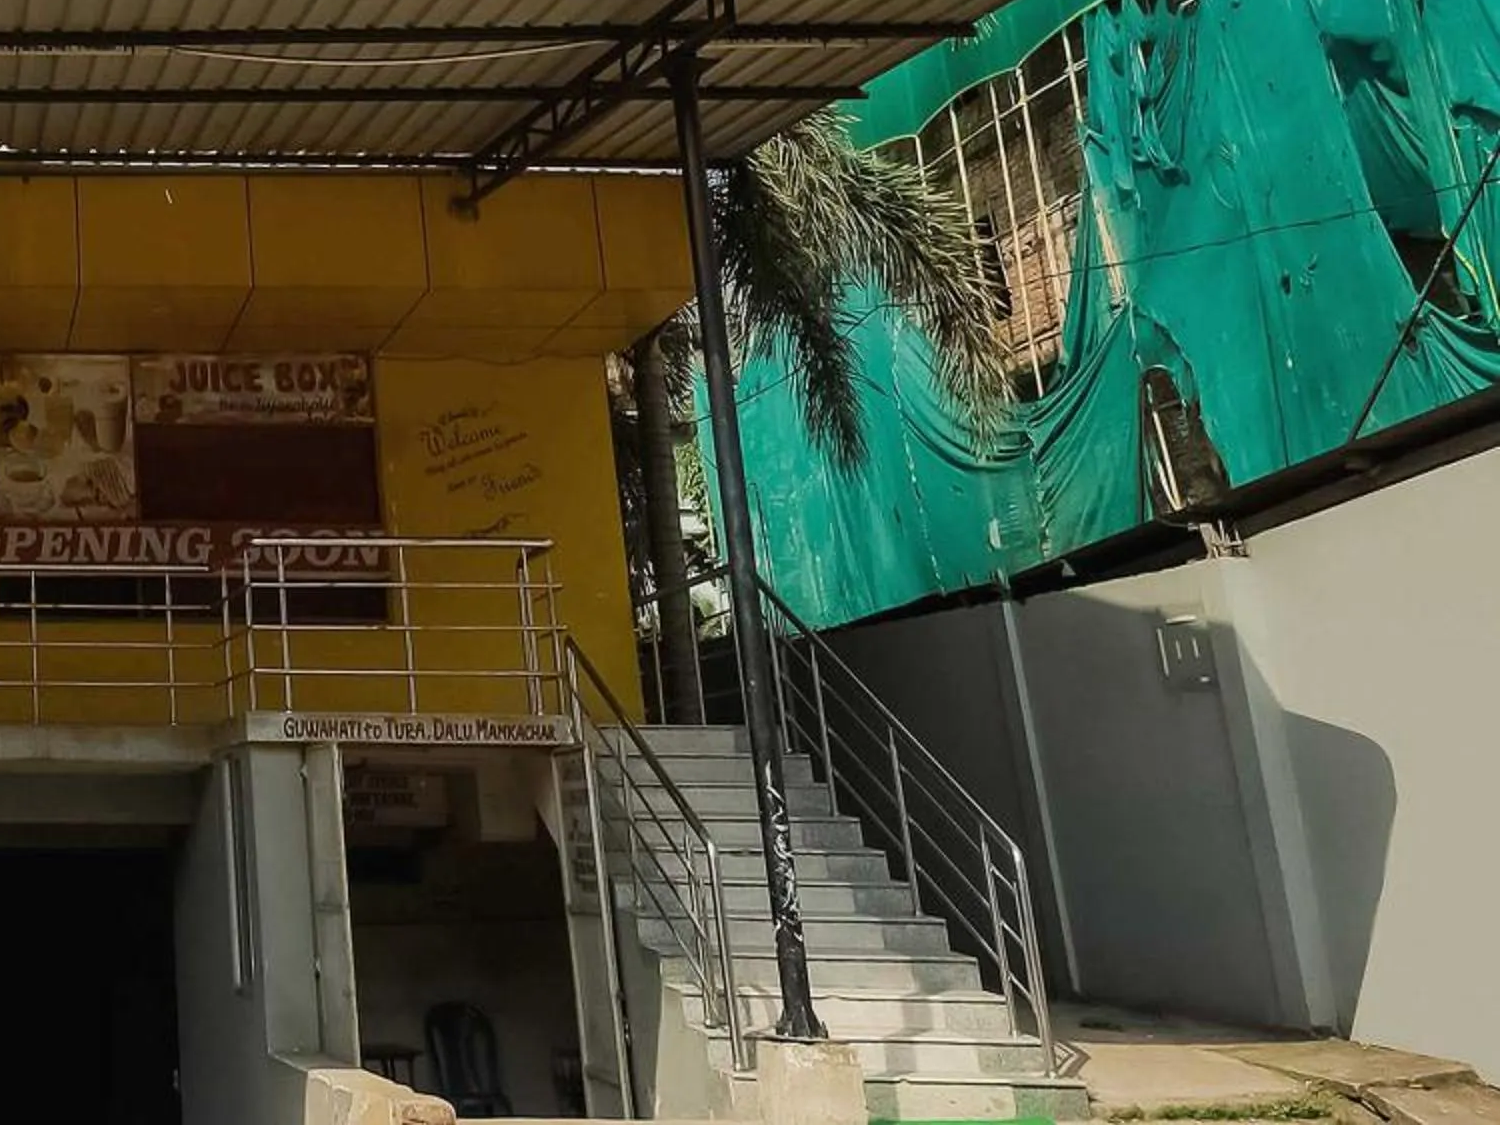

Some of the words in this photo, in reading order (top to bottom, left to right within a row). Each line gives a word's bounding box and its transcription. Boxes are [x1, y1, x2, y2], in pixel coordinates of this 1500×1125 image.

[169, 362, 263, 392] JUICE
[274, 361, 338, 392] BOX
[231, 529, 386, 567] SOON
[284, 717, 361, 739] GUWAHATI
[433, 717, 473, 741] DALU
